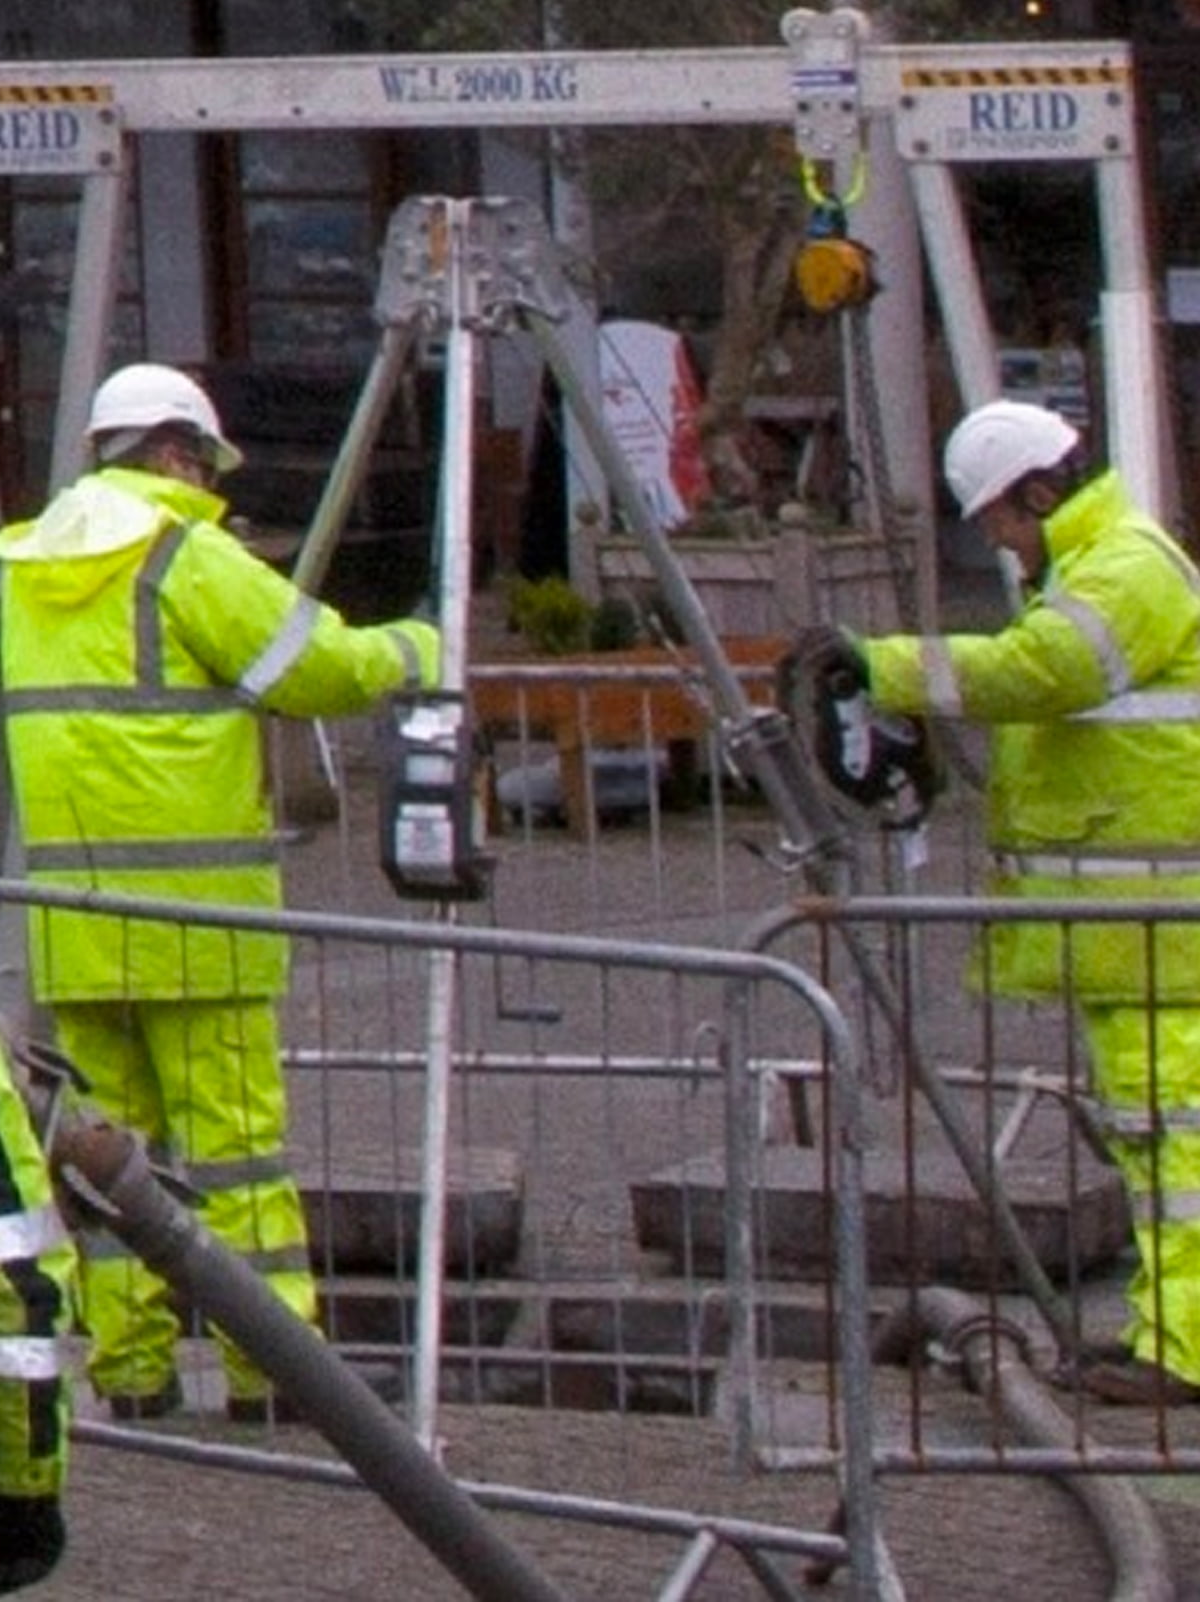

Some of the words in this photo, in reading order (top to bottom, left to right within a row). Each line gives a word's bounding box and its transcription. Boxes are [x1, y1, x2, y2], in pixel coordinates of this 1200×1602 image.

[454, 66, 522, 101] 2000
[531, 63, 579, 100] KG
[970, 91, 1078, 131] REID
